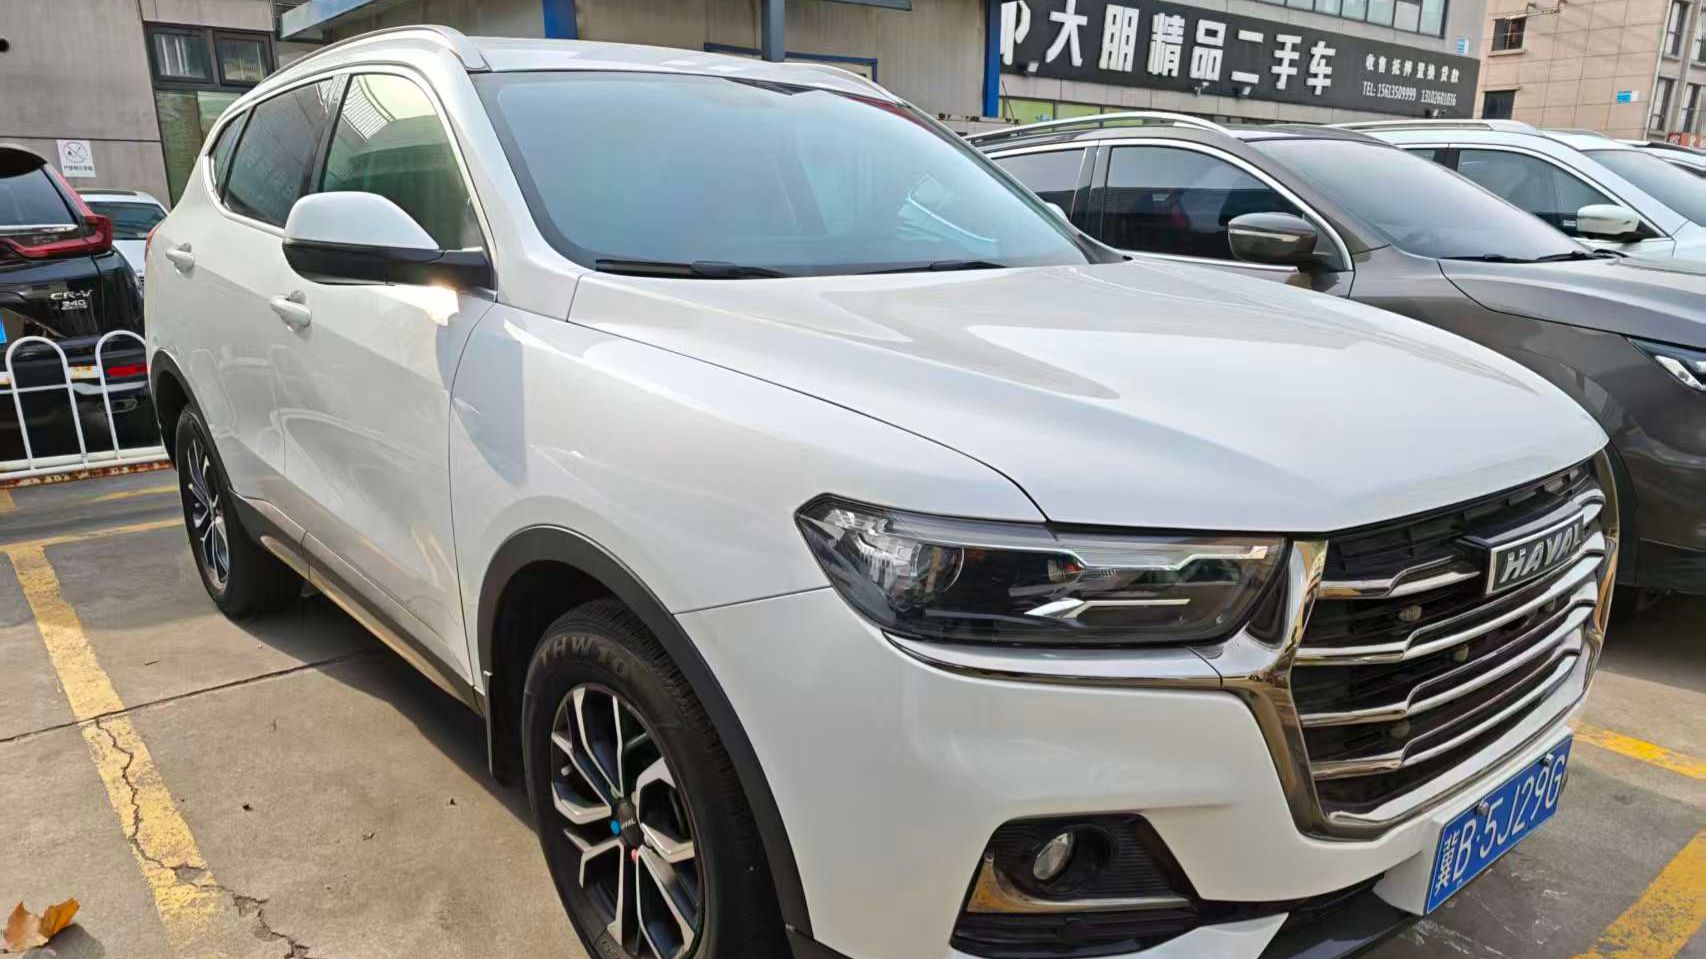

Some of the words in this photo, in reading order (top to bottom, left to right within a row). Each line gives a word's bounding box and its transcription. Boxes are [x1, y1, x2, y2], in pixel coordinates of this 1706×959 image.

[1044, 0, 1337, 96] 大朋精品二手车
[50, 289, 93, 301] CR-V
[1499, 523, 1582, 583] HAVAL
